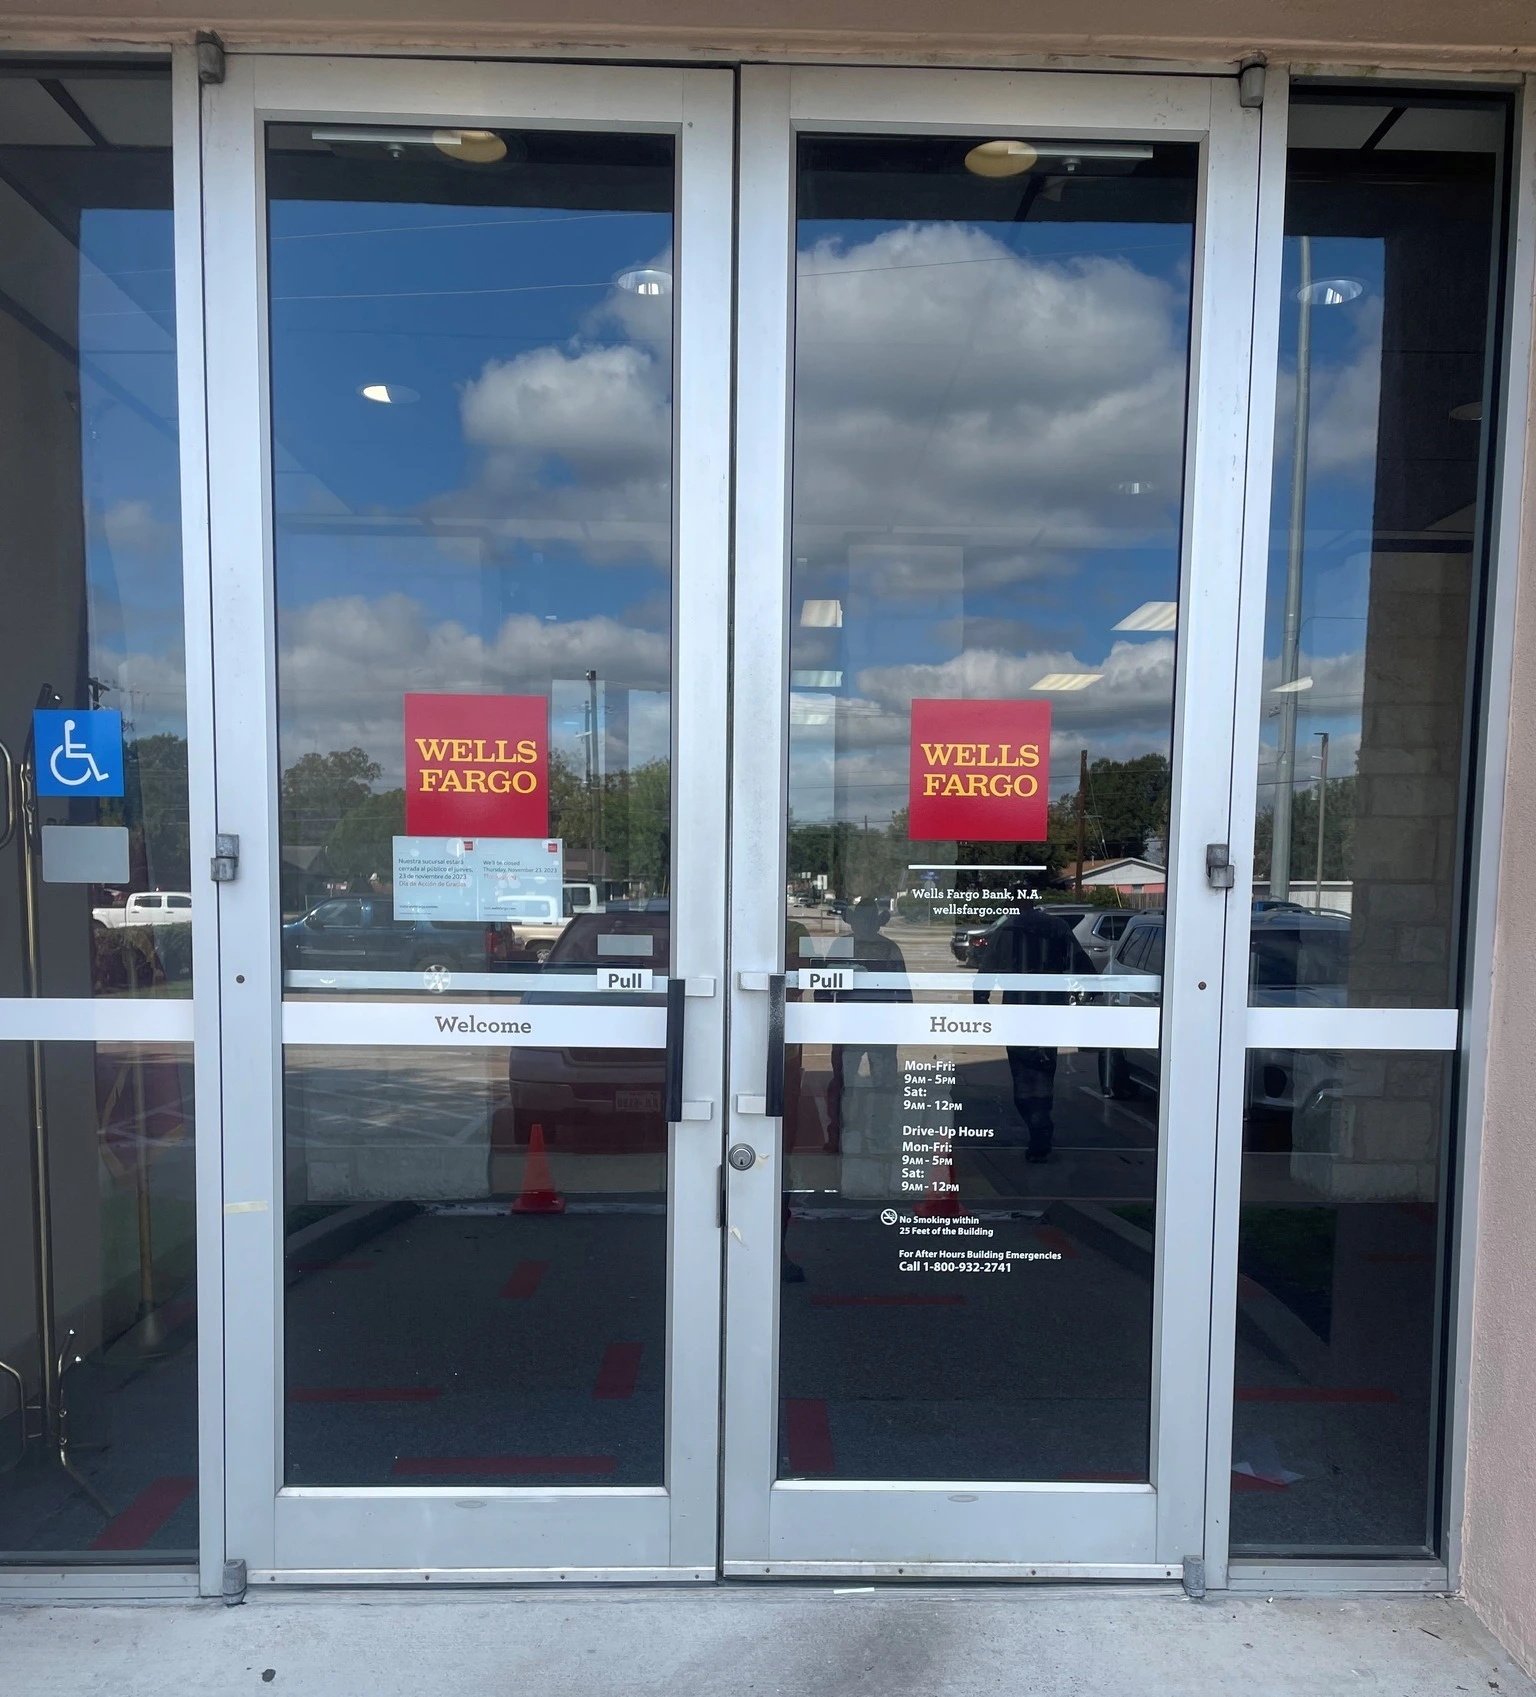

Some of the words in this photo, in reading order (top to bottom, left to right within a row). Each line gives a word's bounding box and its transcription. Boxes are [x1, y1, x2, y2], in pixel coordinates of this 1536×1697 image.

[415, 738, 538, 763] WELLS
[920, 743, 1040, 768] WELLS
[419, 769, 537, 794] FARGO
[922, 773, 1039, 797] FARGO
[912, 888, 944, 899] Wells
[946, 889, 980, 901] Fargo
[982, 889, 1014, 901] Bank,
[1017, 889, 1042, 900] N.A.
[932, 904, 1021, 917] wellsfargo.com
[608, 973, 642, 989] Pull
[809, 973, 843, 989] Pull
[434, 1015, 532, 1034] Welcome
[930, 1016, 992, 1033] Hours
[904, 1060, 955, 1072] Mon-Fri:
[903, 1086, 927, 1097] Sat:
[902, 1125, 956, 1139] Drive-Up
[958, 1126, 995, 1138] Hours
[902, 1141, 953, 1152] Mon-Fri:
[901, 1168, 925, 1178] Sat:
[899, 1216, 912, 1224] No
[913, 1215, 950, 1226] Smoking
[952, 1216, 979, 1225] within
[899, 1227, 910, 1235] 25
[911, 1227, 930, 1235] Feet
[931, 1227, 942, 1235] of
[943, 1227, 957, 1235] the
[957, 1227, 994, 1238] Building
[899, 1250, 913, 1258] For
[914, 1250, 938, 1259] After
[939, 1250, 966, 1259] Hours
[967, 1251, 1004, 1261] Building
[1005, 1251, 1062, 1262] Emergencies
[899, 1261, 921, 1272] Call
[923, 1261, 1012, 1273] 1-800-932-2741
